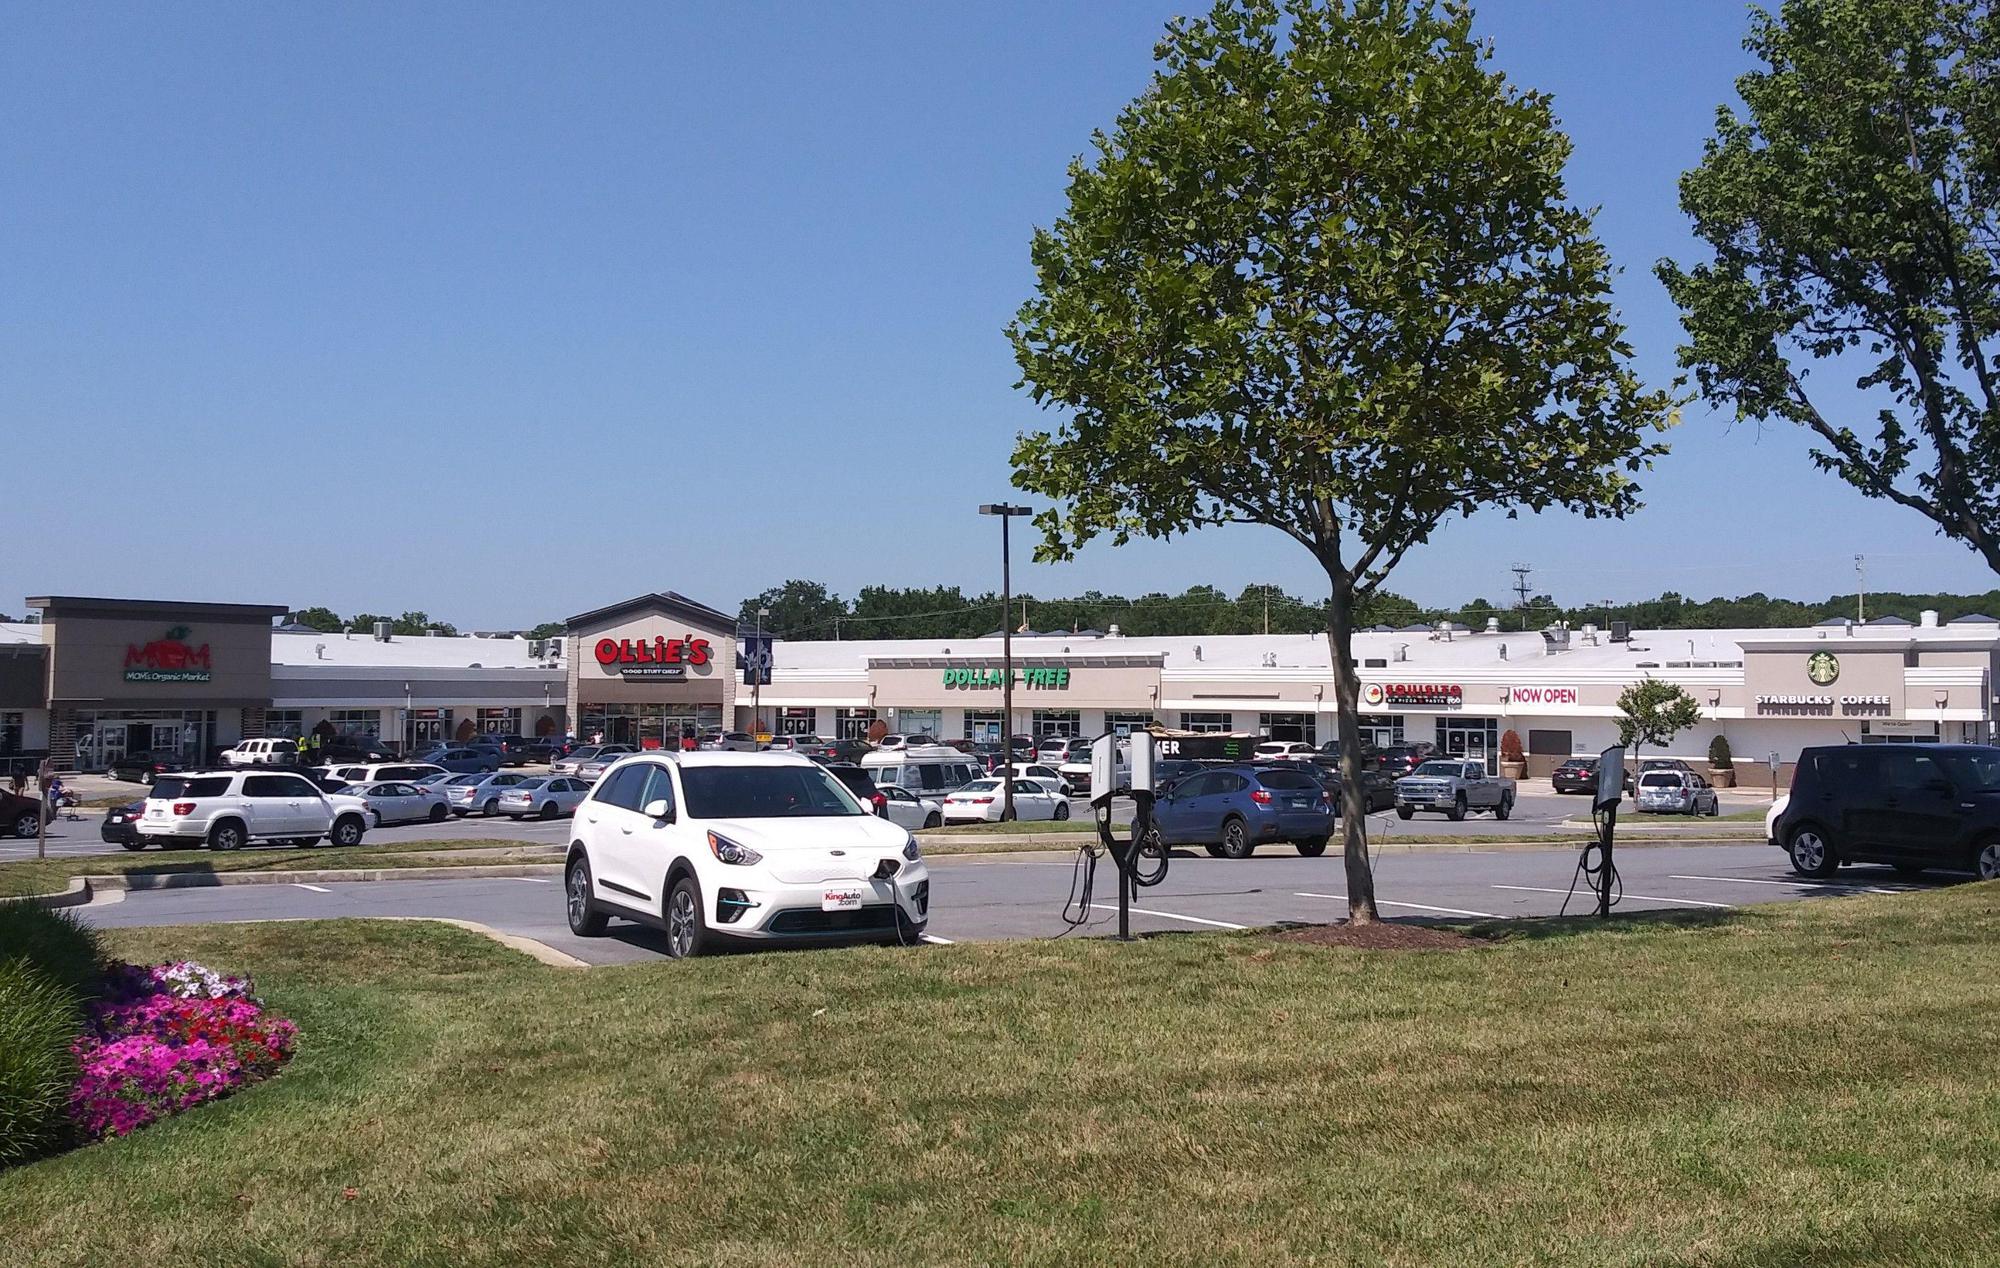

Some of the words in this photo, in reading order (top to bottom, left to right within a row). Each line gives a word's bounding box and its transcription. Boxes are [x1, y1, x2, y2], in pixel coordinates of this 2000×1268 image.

[151, 672, 181, 682] Organic
[181, 671, 210, 681] Market
[1023, 668, 1069, 685] TREE
[1386, 684, 1461, 697] SQUISITO
[1513, 688, 1542, 703] NOW
[1544, 688, 1576, 703] OPEN
[1755, 695, 1832, 705] STARBUCKS
[1840, 695, 1890, 705] COFFEE
[1157, 740, 1181, 755] ER
